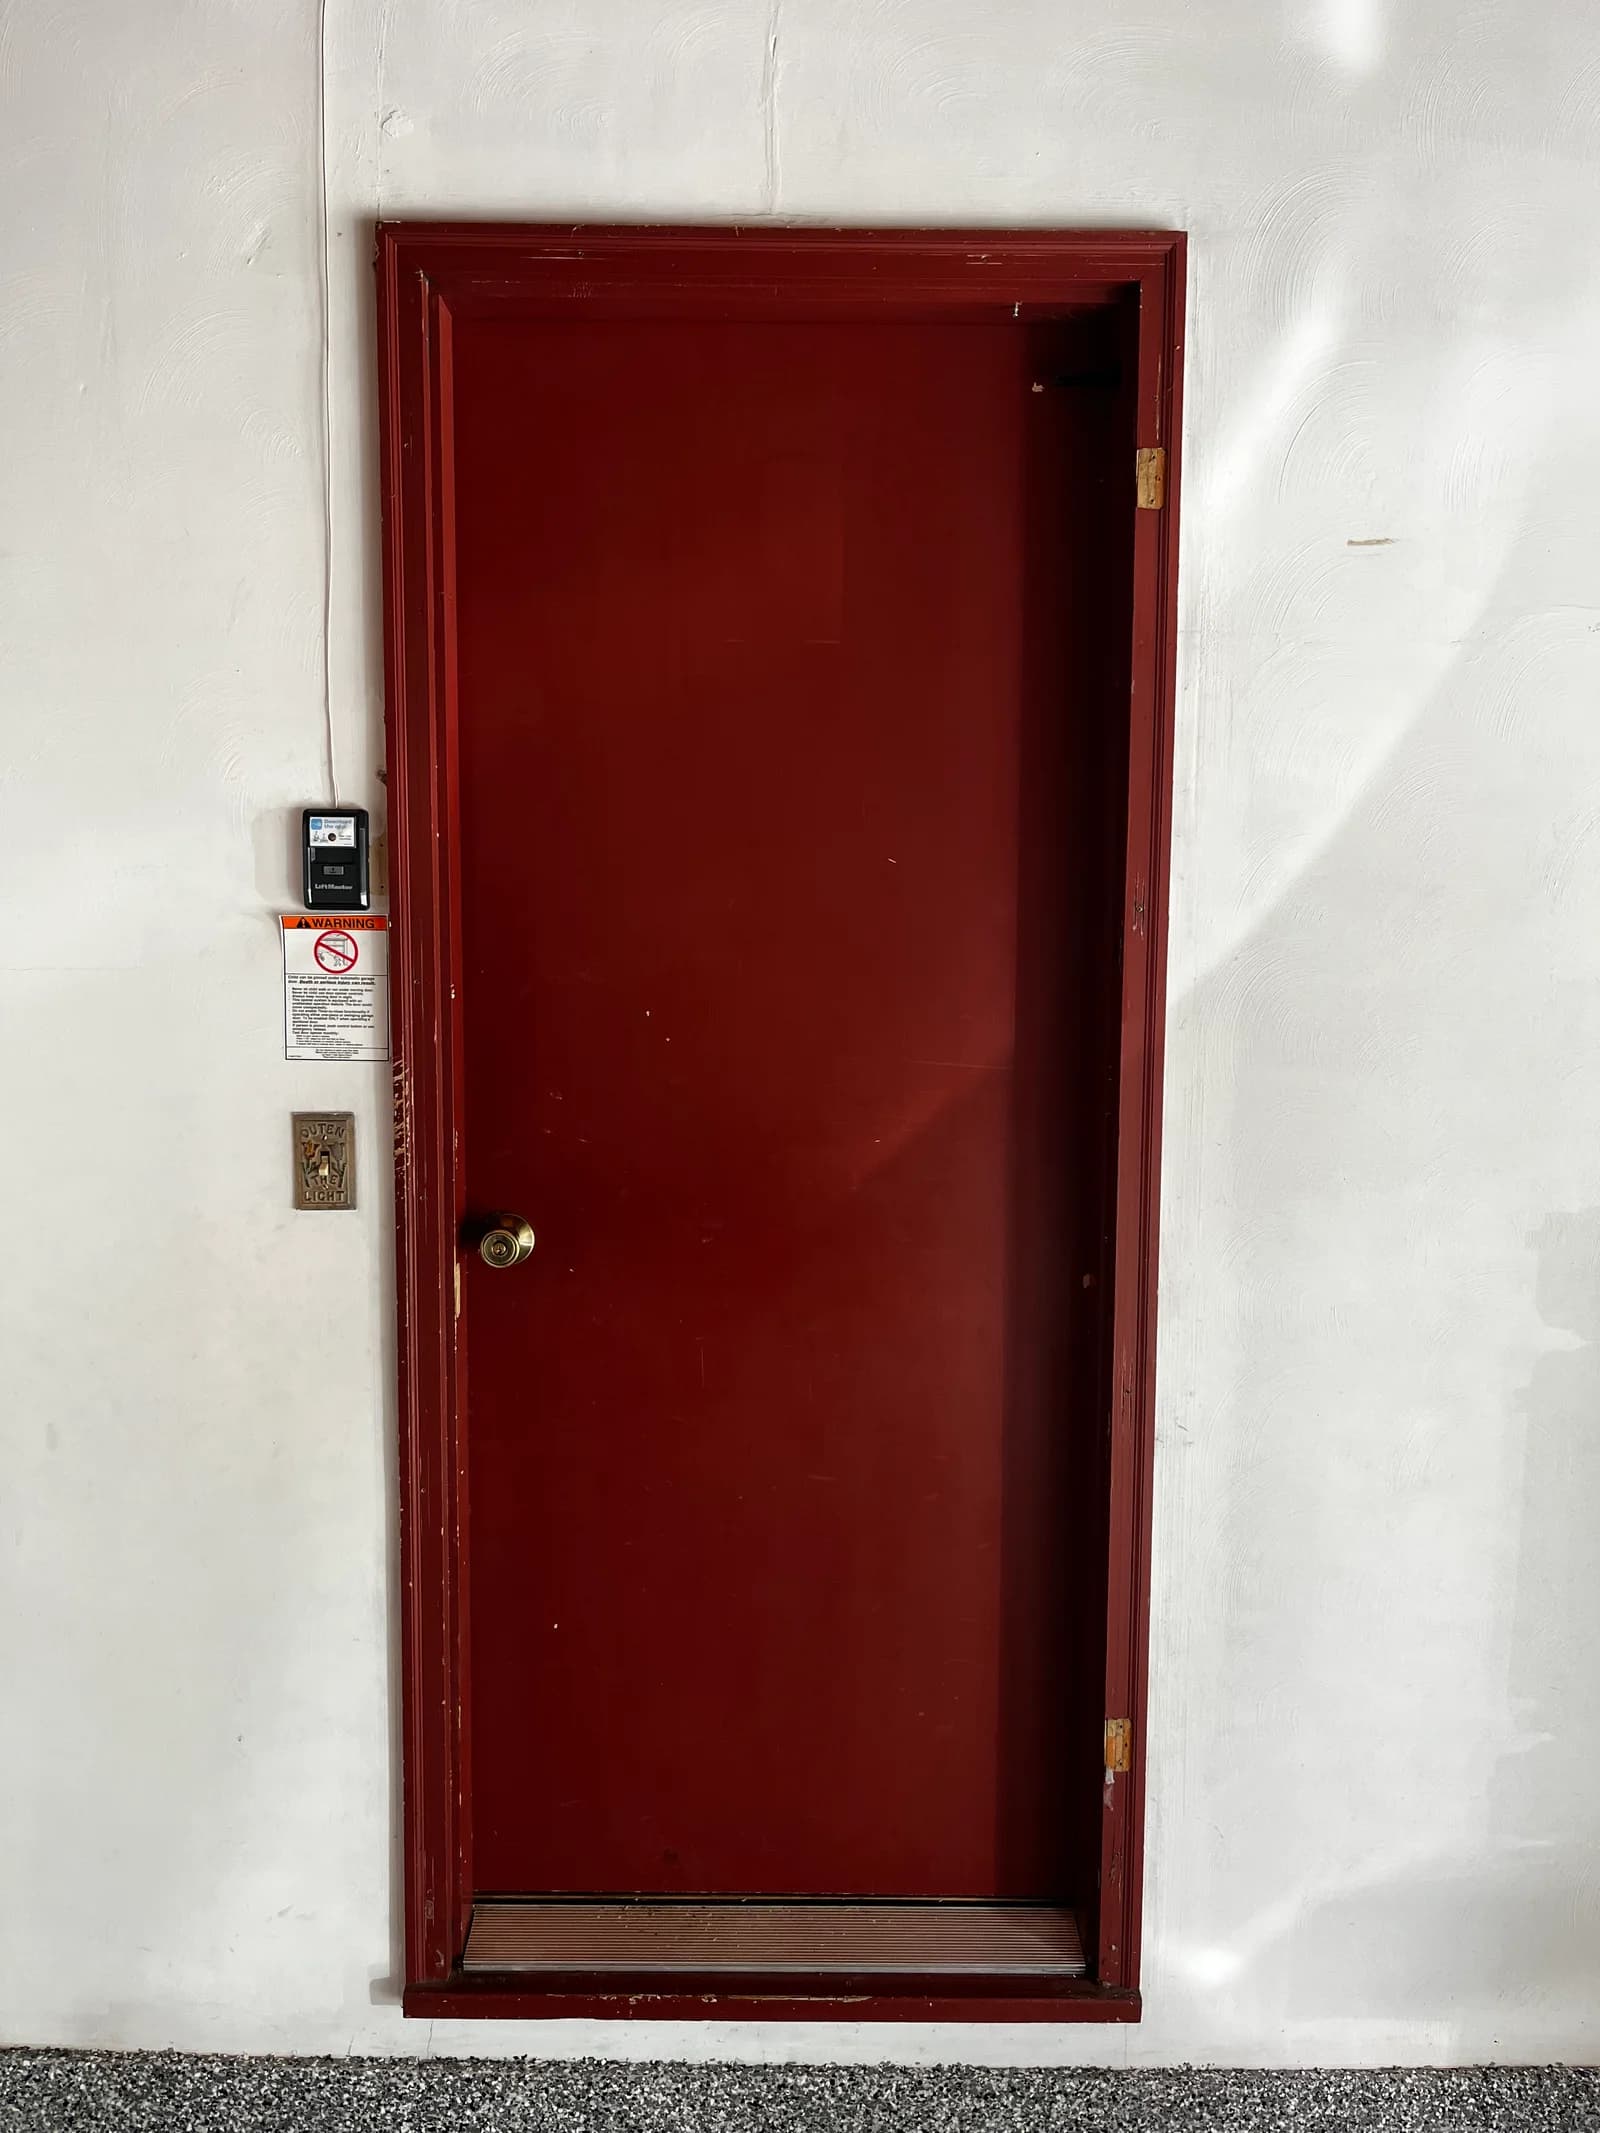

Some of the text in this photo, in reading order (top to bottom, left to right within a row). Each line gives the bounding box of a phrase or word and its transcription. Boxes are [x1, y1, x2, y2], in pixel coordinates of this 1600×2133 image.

[311, 918, 375, 929] WARNING
[300, 1123, 345, 1138] OUTEN
[310, 1174, 339, 1185] THE
[304, 1190, 345, 1202] LIGHT
